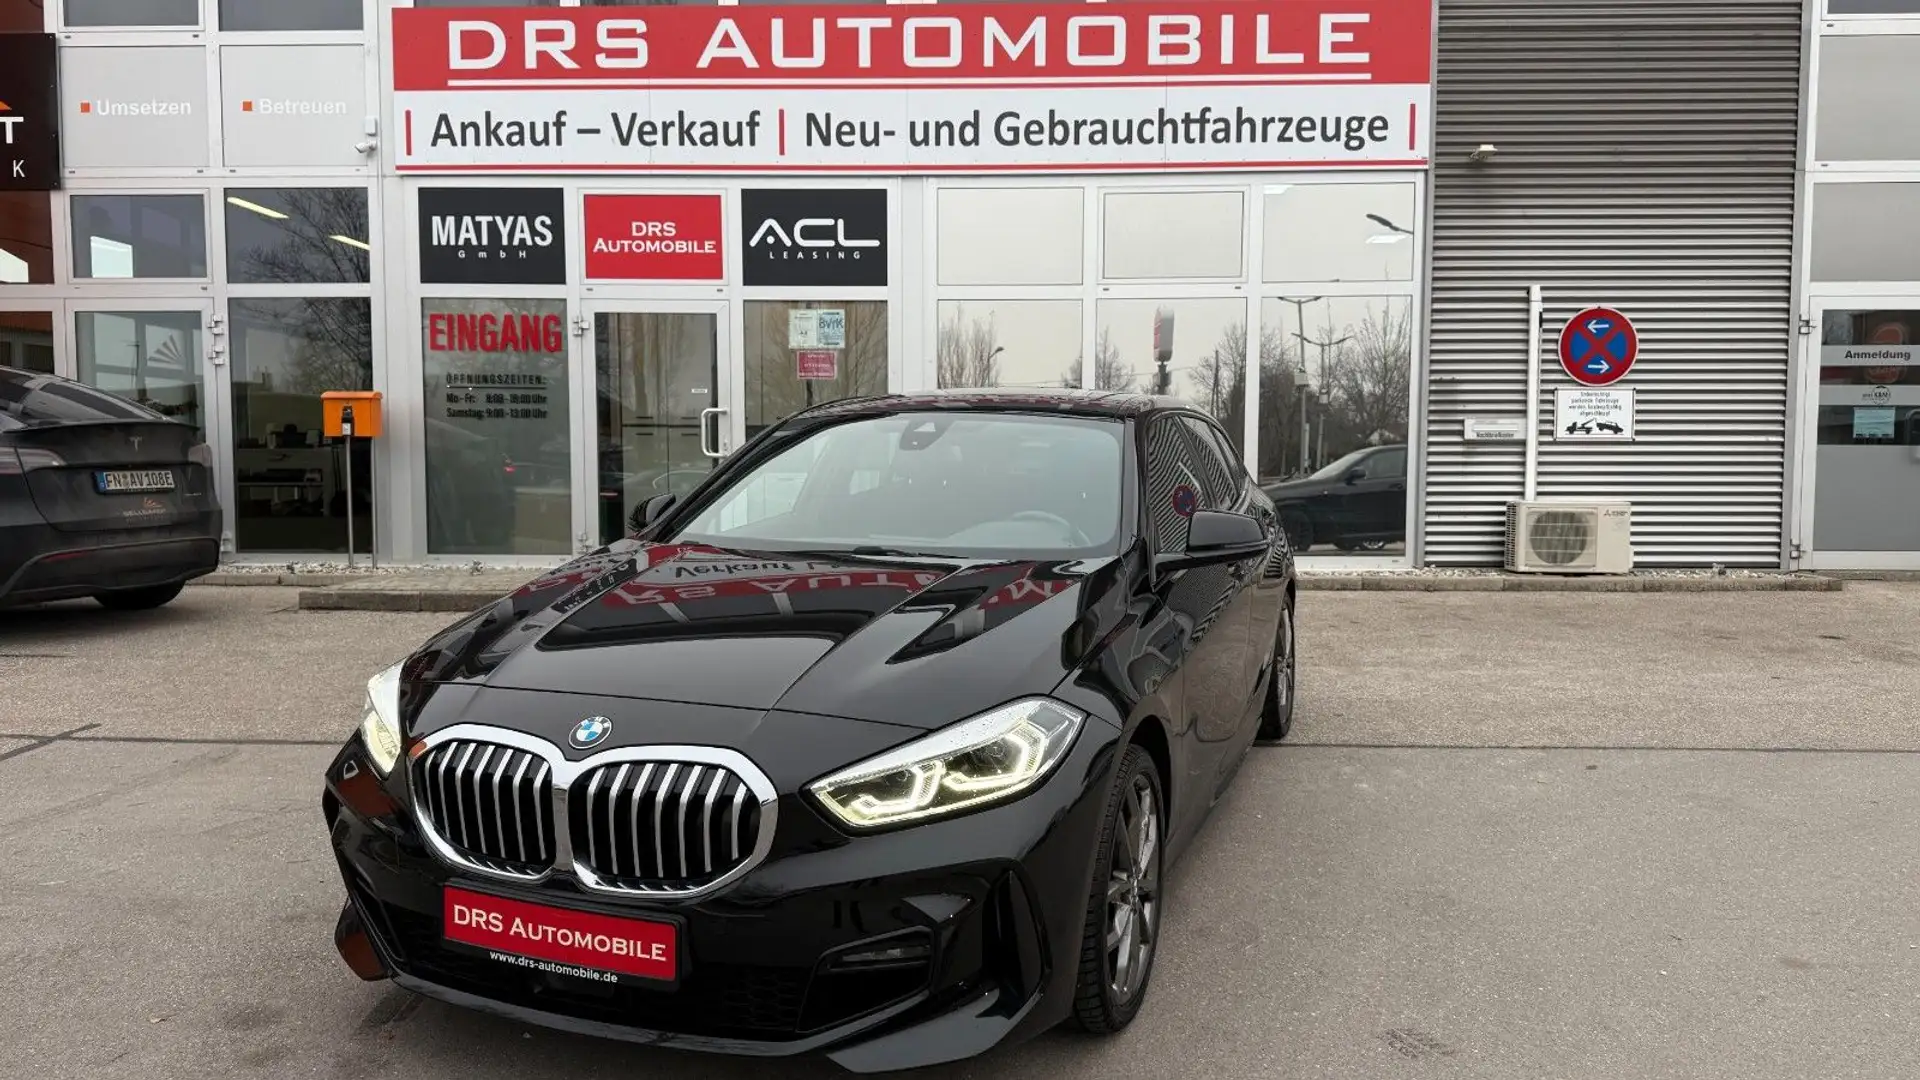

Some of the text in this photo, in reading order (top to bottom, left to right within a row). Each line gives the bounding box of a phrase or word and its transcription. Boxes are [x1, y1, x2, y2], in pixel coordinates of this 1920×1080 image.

[447, 13, 1371, 70] DRS AUTOMOBILE
[97, 100, 191, 116] Umsetzen
[260, 99, 347, 115] Betreuen
[431, 110, 567, 148] Ankauf
[611, 110, 760, 148] Verkauf
[806, 112, 896, 147] Neu-
[909, 109, 980, 147] und
[993, 106, 1389, 151] Gebrauchtfahrzeuge
[13, 160, 25, 178] K
[431, 215, 553, 247] MATYAS
[631, 222, 677, 237] DRS
[749, 218, 880, 247] ACL
[593, 237, 716, 254] AUTOMOBILE
[769, 251, 861, 260] LEASING
[429, 312, 563, 352] EINGANG
[1844, 350, 1911, 361] Anmeldung
[532, 394, 547, 404] Uhr
[532, 408, 547, 418] Uhr
[105, 472, 123, 488] FN
[453, 905, 667, 962] DRS AUTOMOBILE
[490, 951, 618, 983] www.drs-automobile.de
